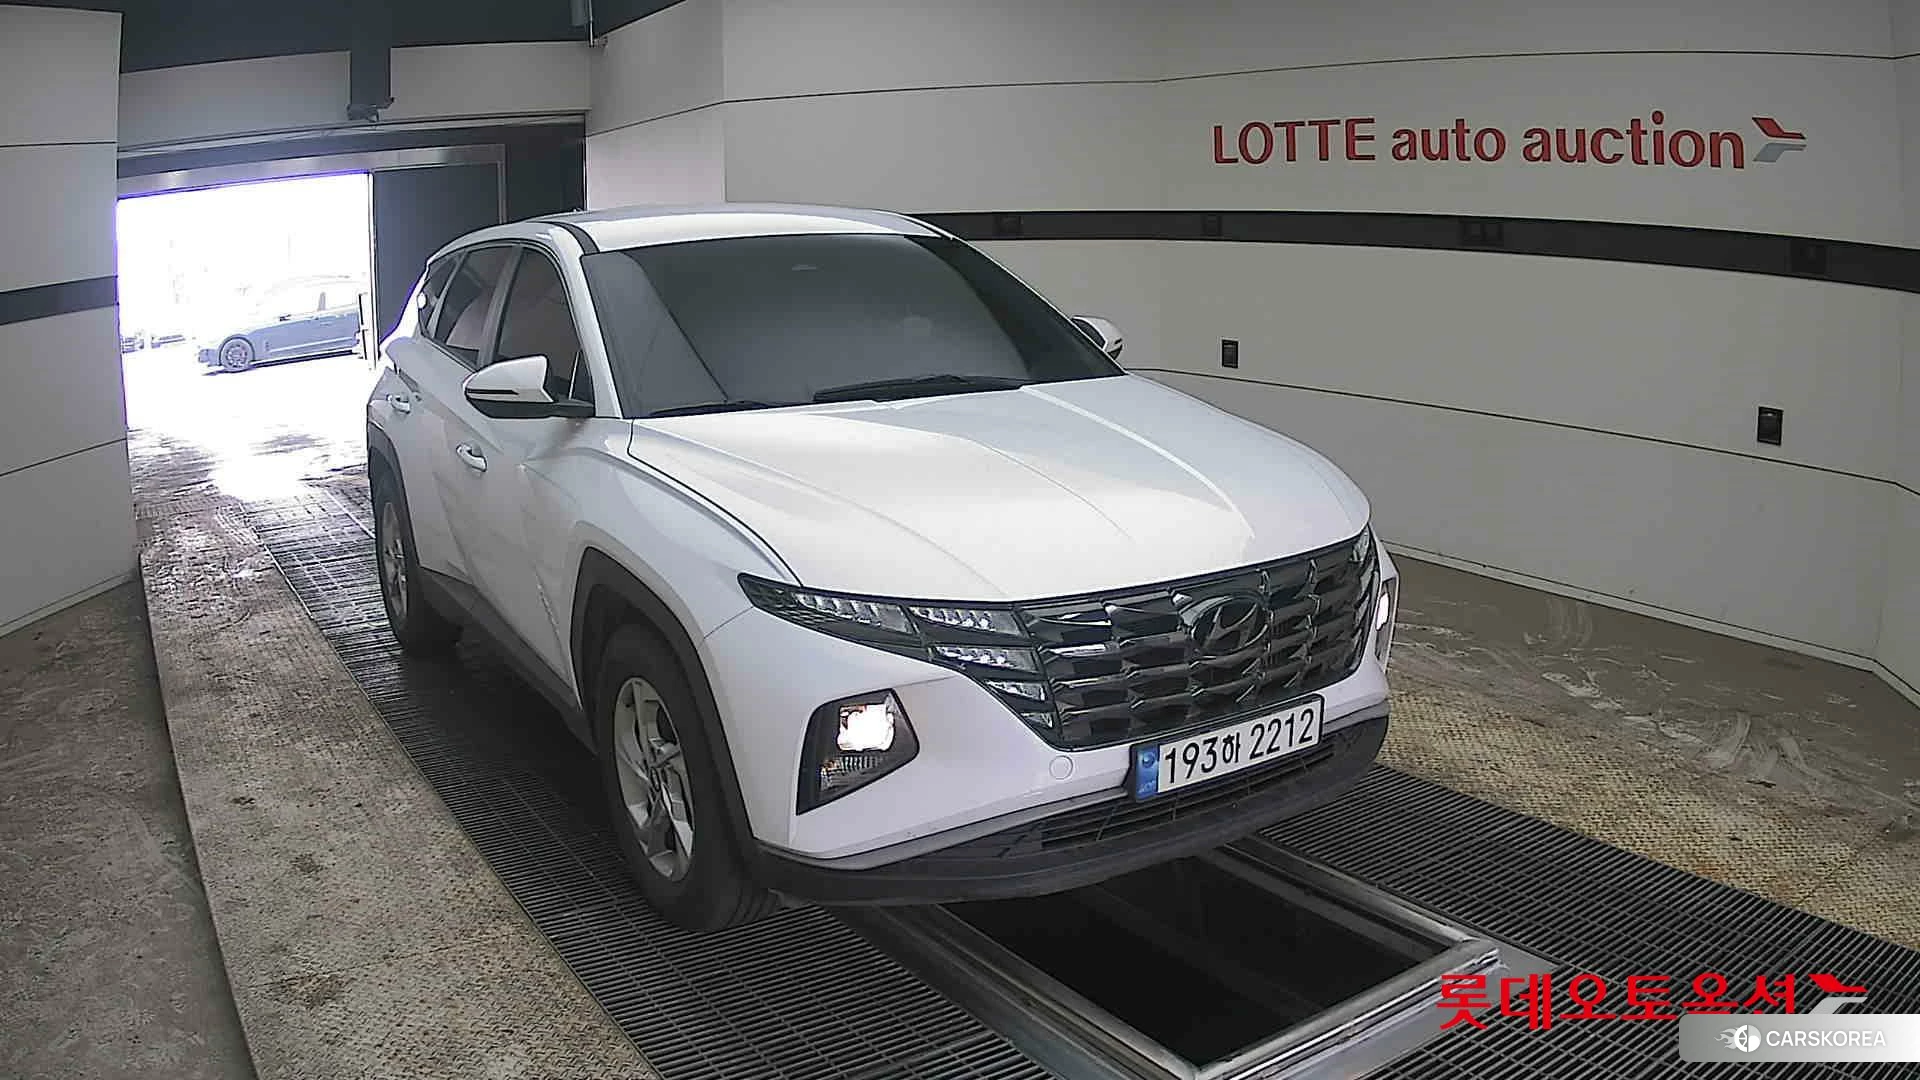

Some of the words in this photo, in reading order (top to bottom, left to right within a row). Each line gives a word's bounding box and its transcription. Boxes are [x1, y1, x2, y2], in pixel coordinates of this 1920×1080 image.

[1213, 117, 1375, 164] LOTTE
[1391, 118, 1506, 162] auto
[1522, 110, 1745, 169] auction
[1164, 732, 1240, 784] 193하
[1249, 708, 1314, 760] 2212
